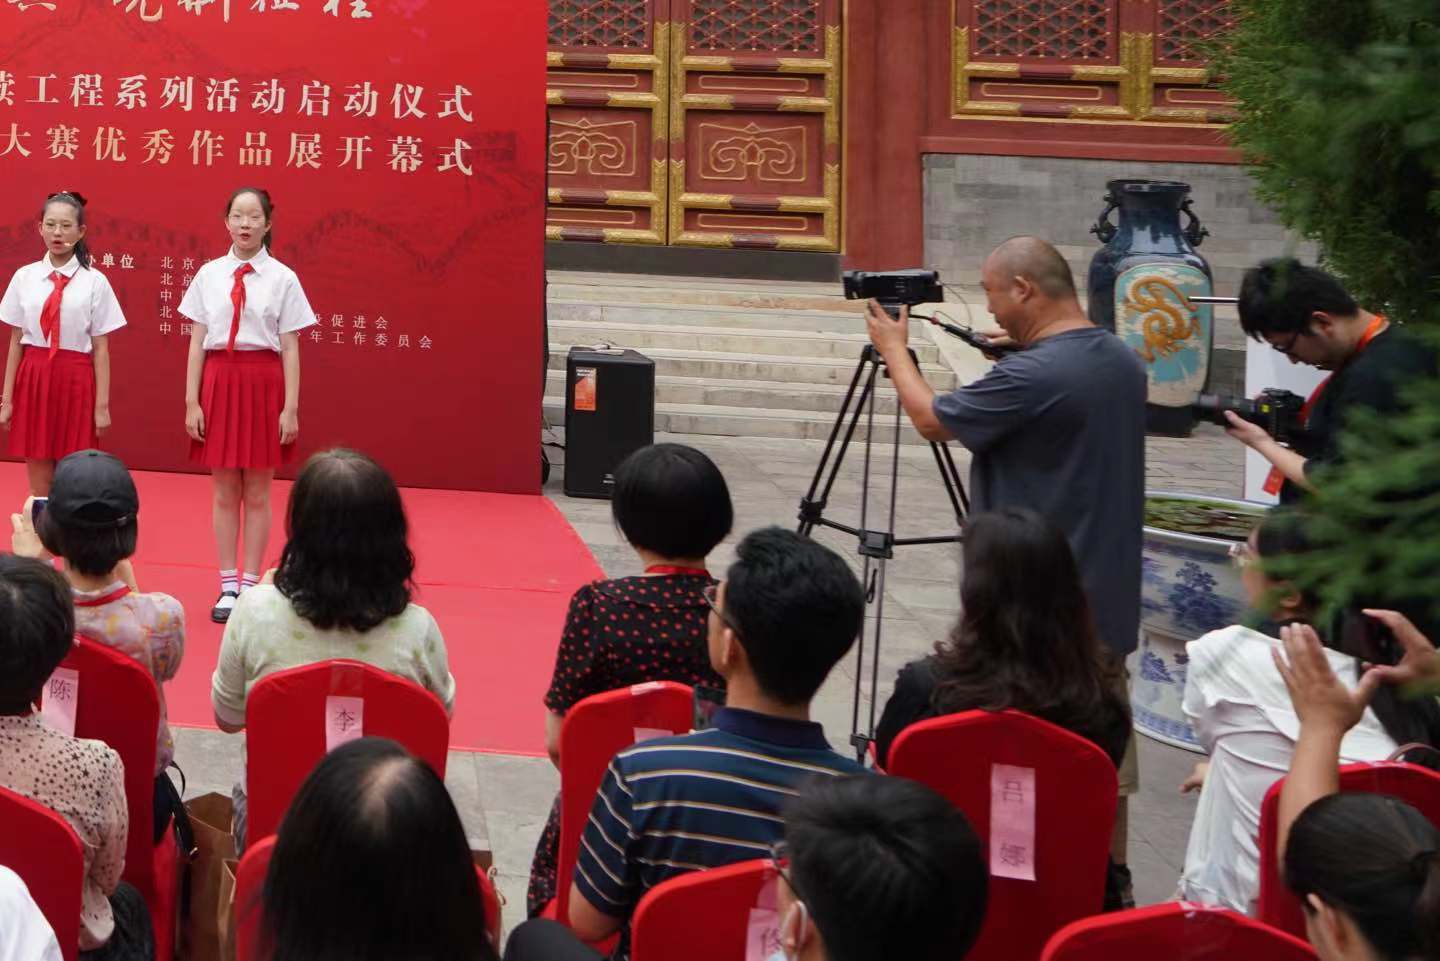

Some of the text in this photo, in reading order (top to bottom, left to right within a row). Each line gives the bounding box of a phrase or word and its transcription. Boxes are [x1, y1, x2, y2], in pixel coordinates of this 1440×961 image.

[297, 329, 433, 349] 年工作委员会
[49, 678, 72, 701] 陈
[334, 708, 355, 732] 李
